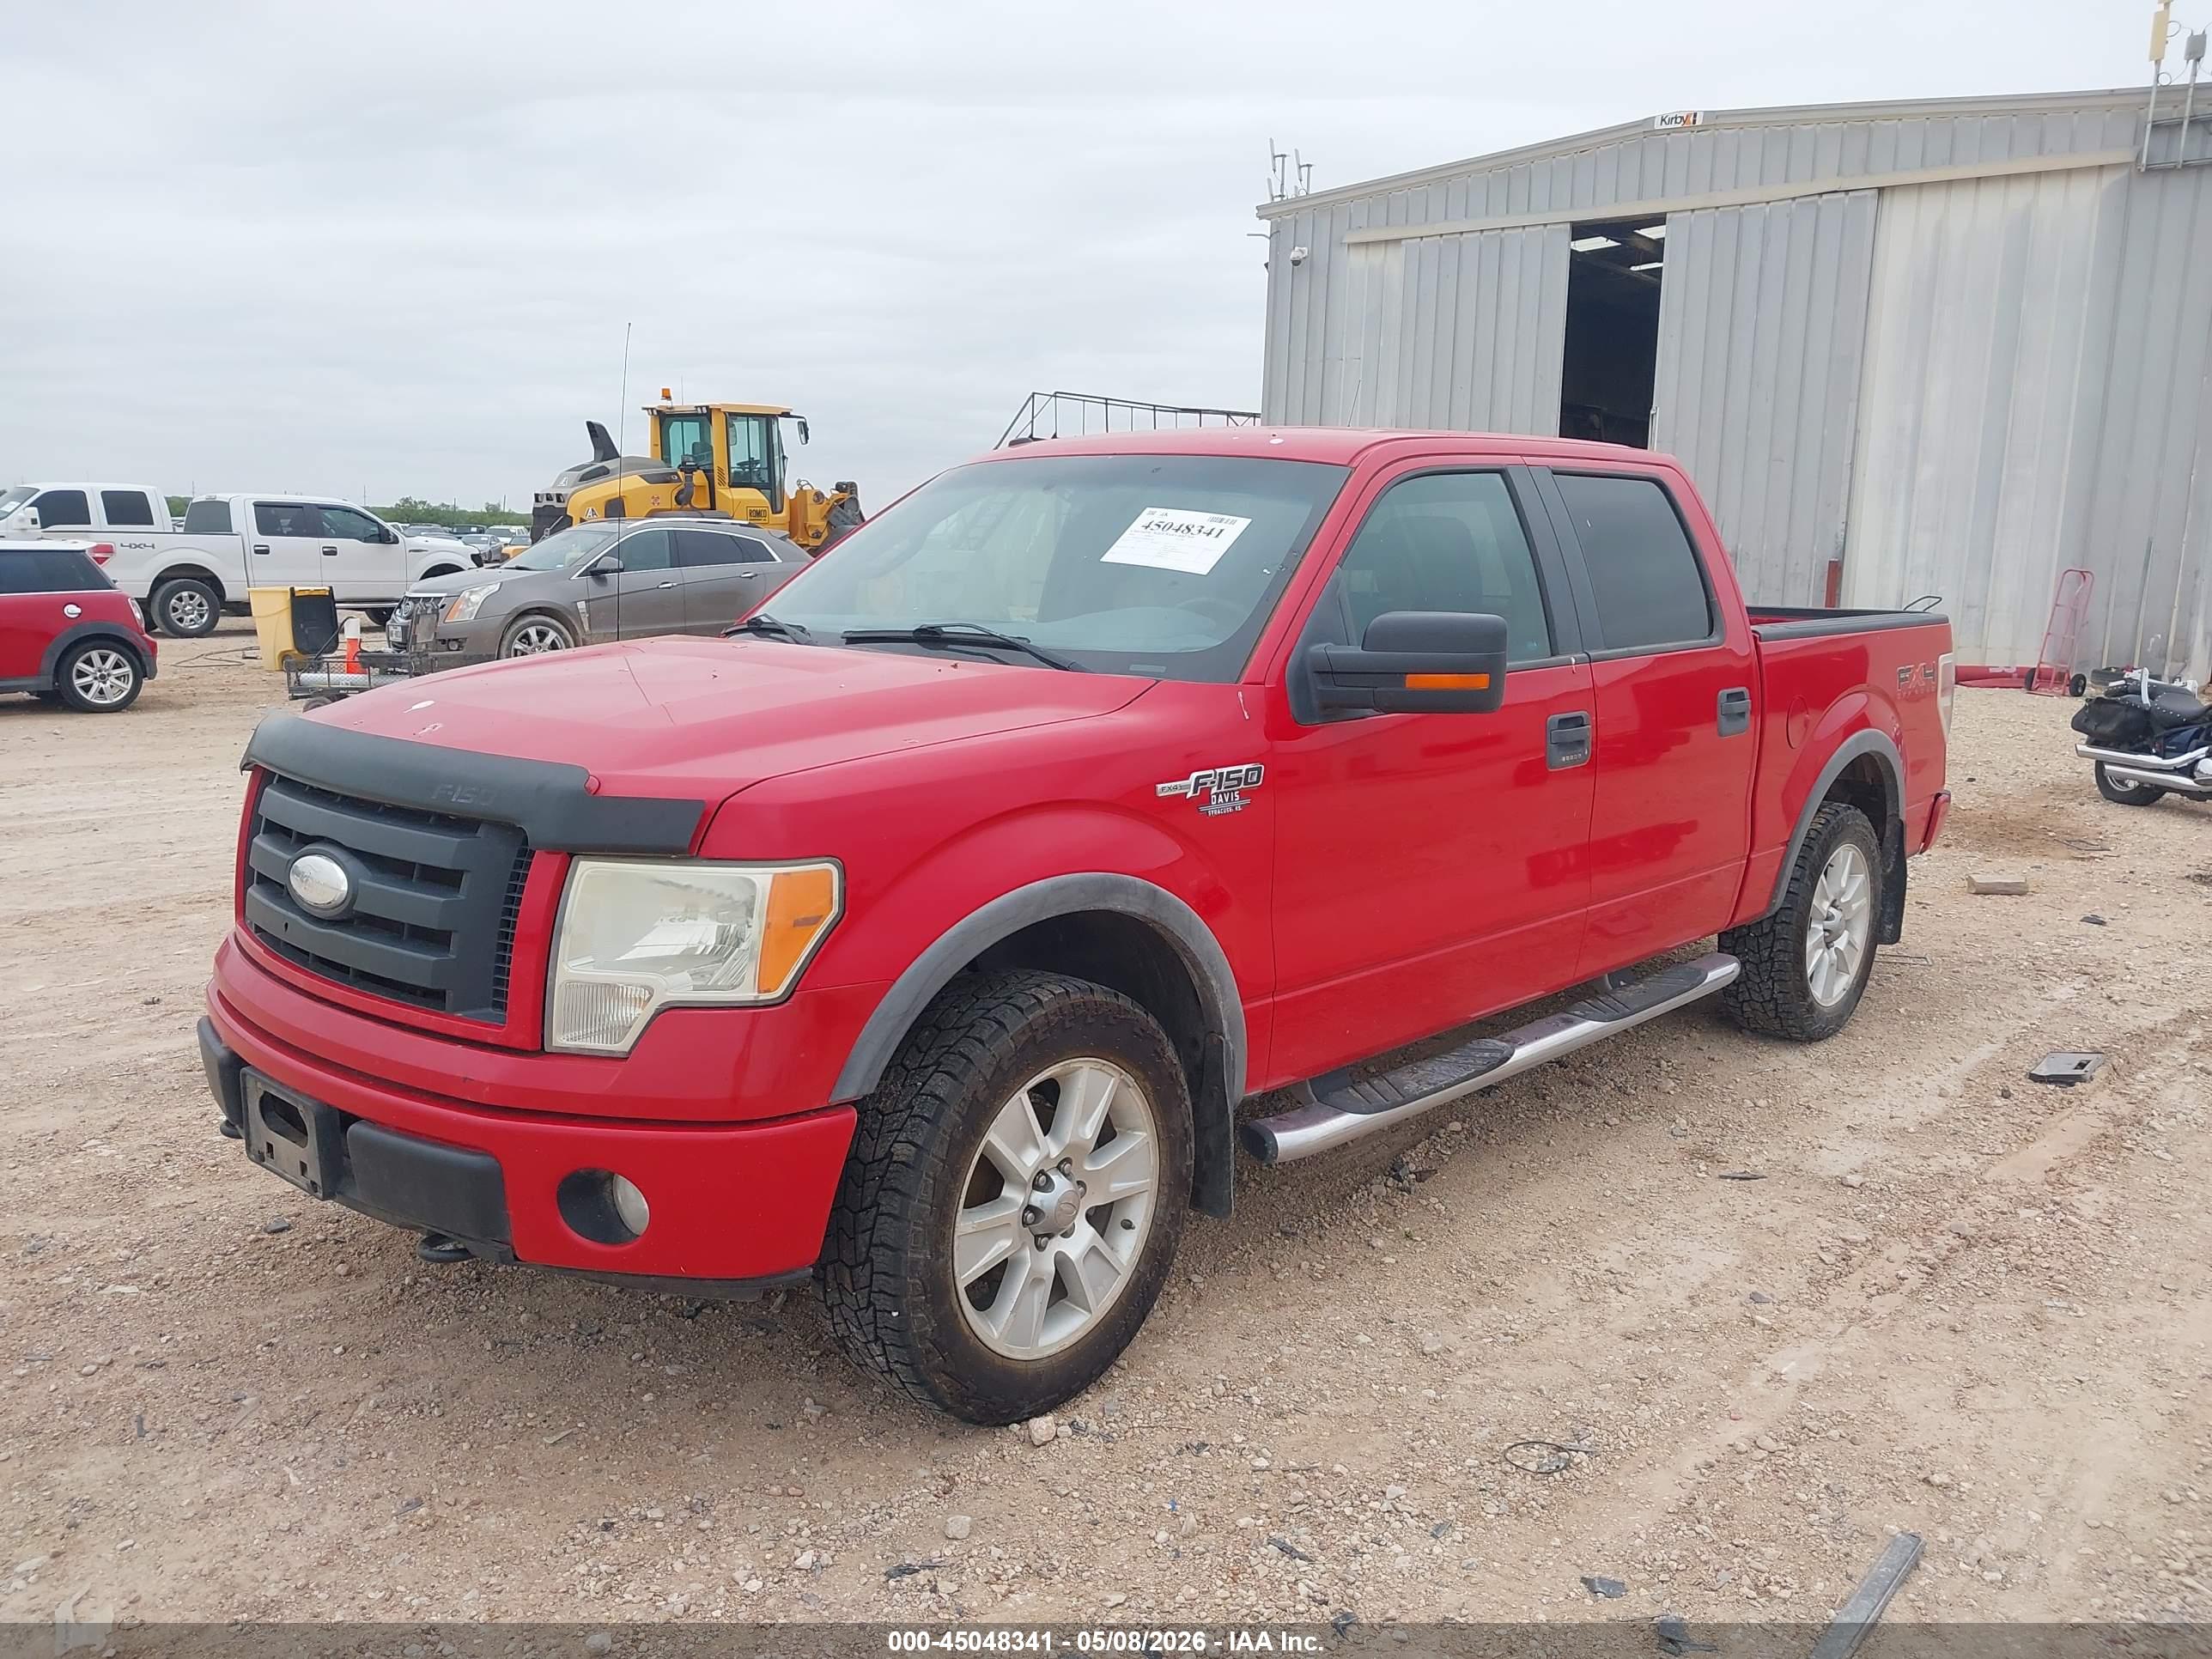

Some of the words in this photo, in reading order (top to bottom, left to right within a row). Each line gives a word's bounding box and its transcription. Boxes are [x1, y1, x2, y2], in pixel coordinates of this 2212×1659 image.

[1660, 114, 1689, 126] Kirby
[1141, 520, 1224, 538] 45048341
[1896, 662, 1936, 691] FX4
[1192, 765, 1262, 795] F-150
[1211, 791, 1240, 805] DAVIS
